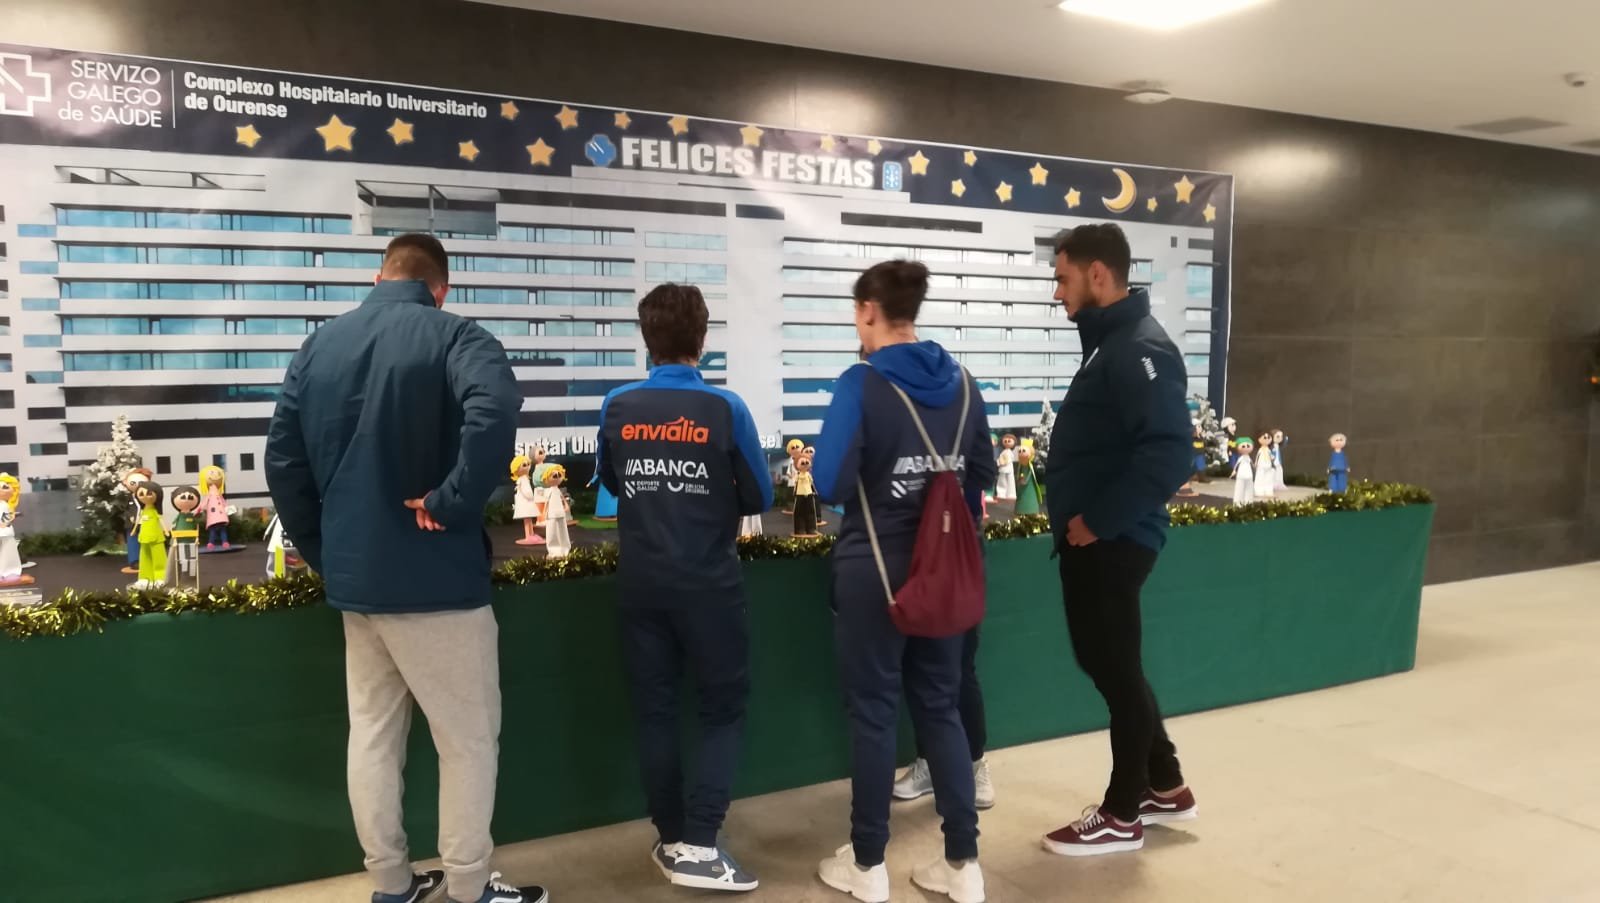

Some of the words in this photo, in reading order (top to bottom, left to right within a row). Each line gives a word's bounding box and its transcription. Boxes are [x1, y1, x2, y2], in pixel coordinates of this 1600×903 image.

[70, 59, 161, 86] SERVIZO
[68, 81, 162, 107] GALEGO
[183, 71, 274, 97] Complexo
[278, 81, 382, 109] Hospitalario
[386, 93, 488, 118] Universitario
[184, 93, 208, 112] de
[212, 95, 288, 118] Ourense
[57, 104, 84, 122] de
[88, 103, 162, 128] SAÚDE
[621, 137, 755, 177] FELICES
[762, 151, 874, 188] FESTAS
